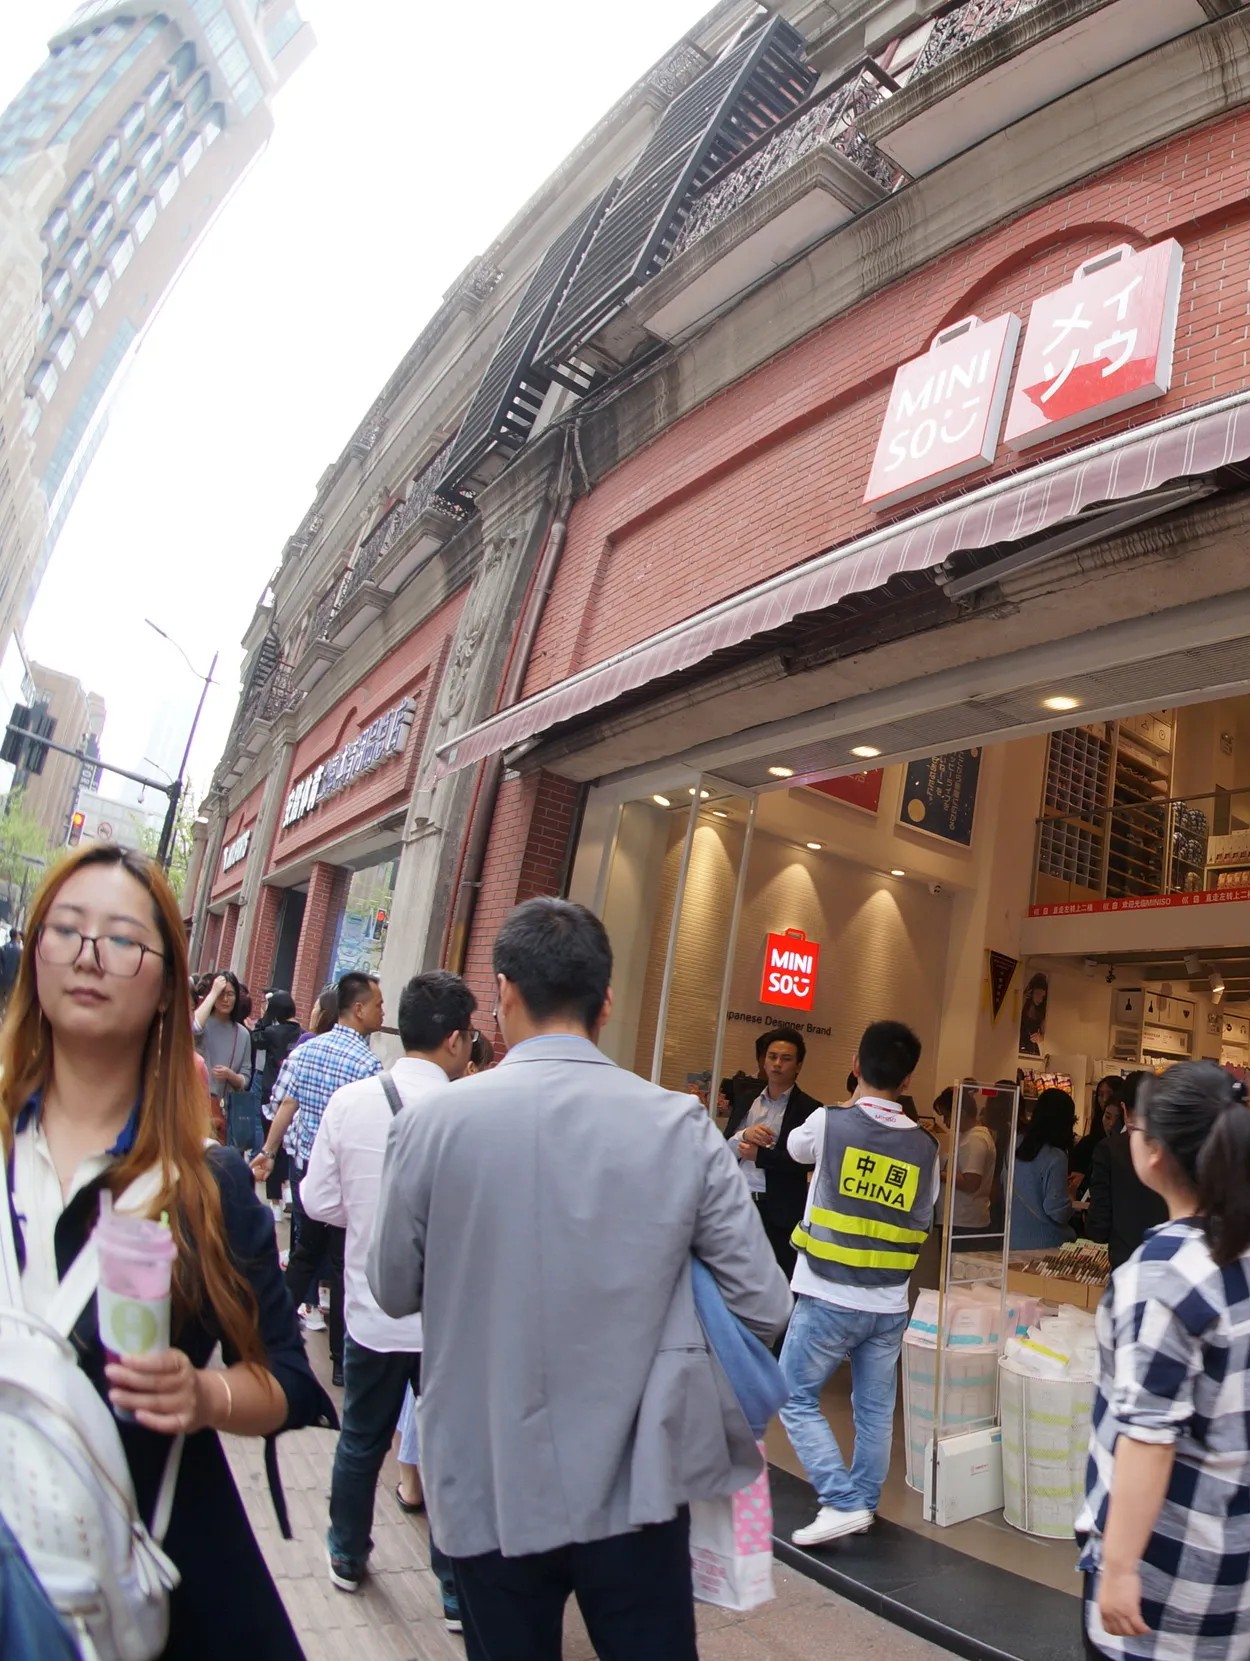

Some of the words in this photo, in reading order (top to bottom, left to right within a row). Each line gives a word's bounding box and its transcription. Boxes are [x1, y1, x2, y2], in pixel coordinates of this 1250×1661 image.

[894, 348, 991, 423] MINI
[1121, 897, 1171, 910] 欢迎光临MINISO
[770, 947, 814, 974] MINI
[806, 1023, 832, 1036] Brand
[856, 1155, 908, 1189] 中国
[843, 1177, 904, 1208] CHINA
